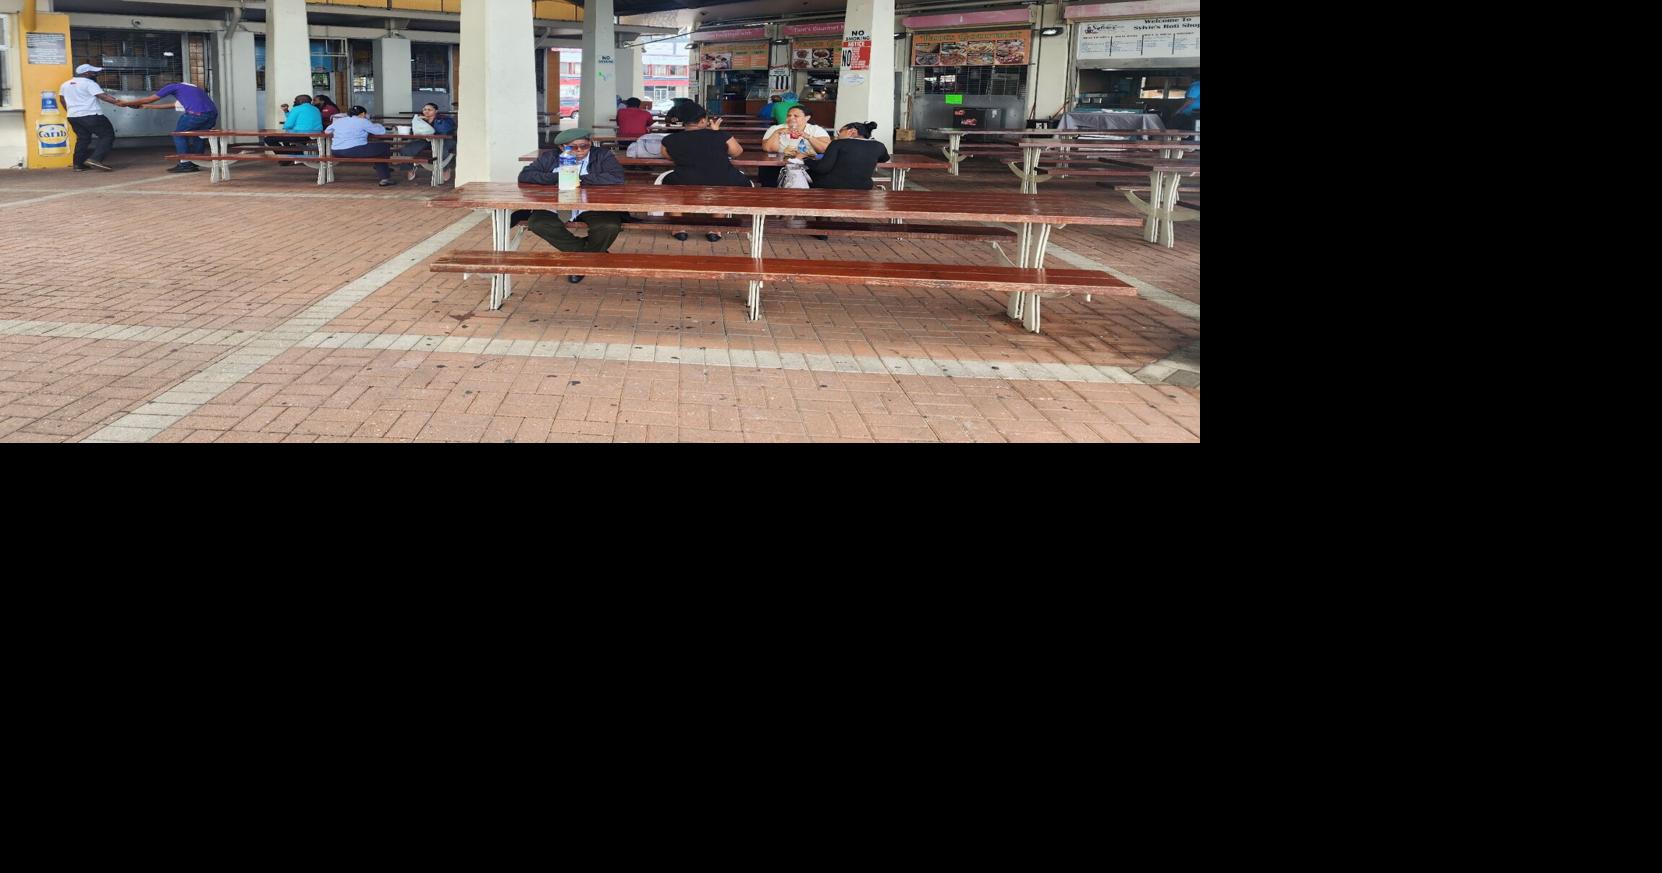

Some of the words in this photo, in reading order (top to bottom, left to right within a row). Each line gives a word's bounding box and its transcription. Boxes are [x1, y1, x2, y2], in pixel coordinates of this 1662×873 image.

[1134, 23, 1161, 31] Sylvie's
[841, 49, 852, 67] NO
[38, 129, 67, 139] Carib
